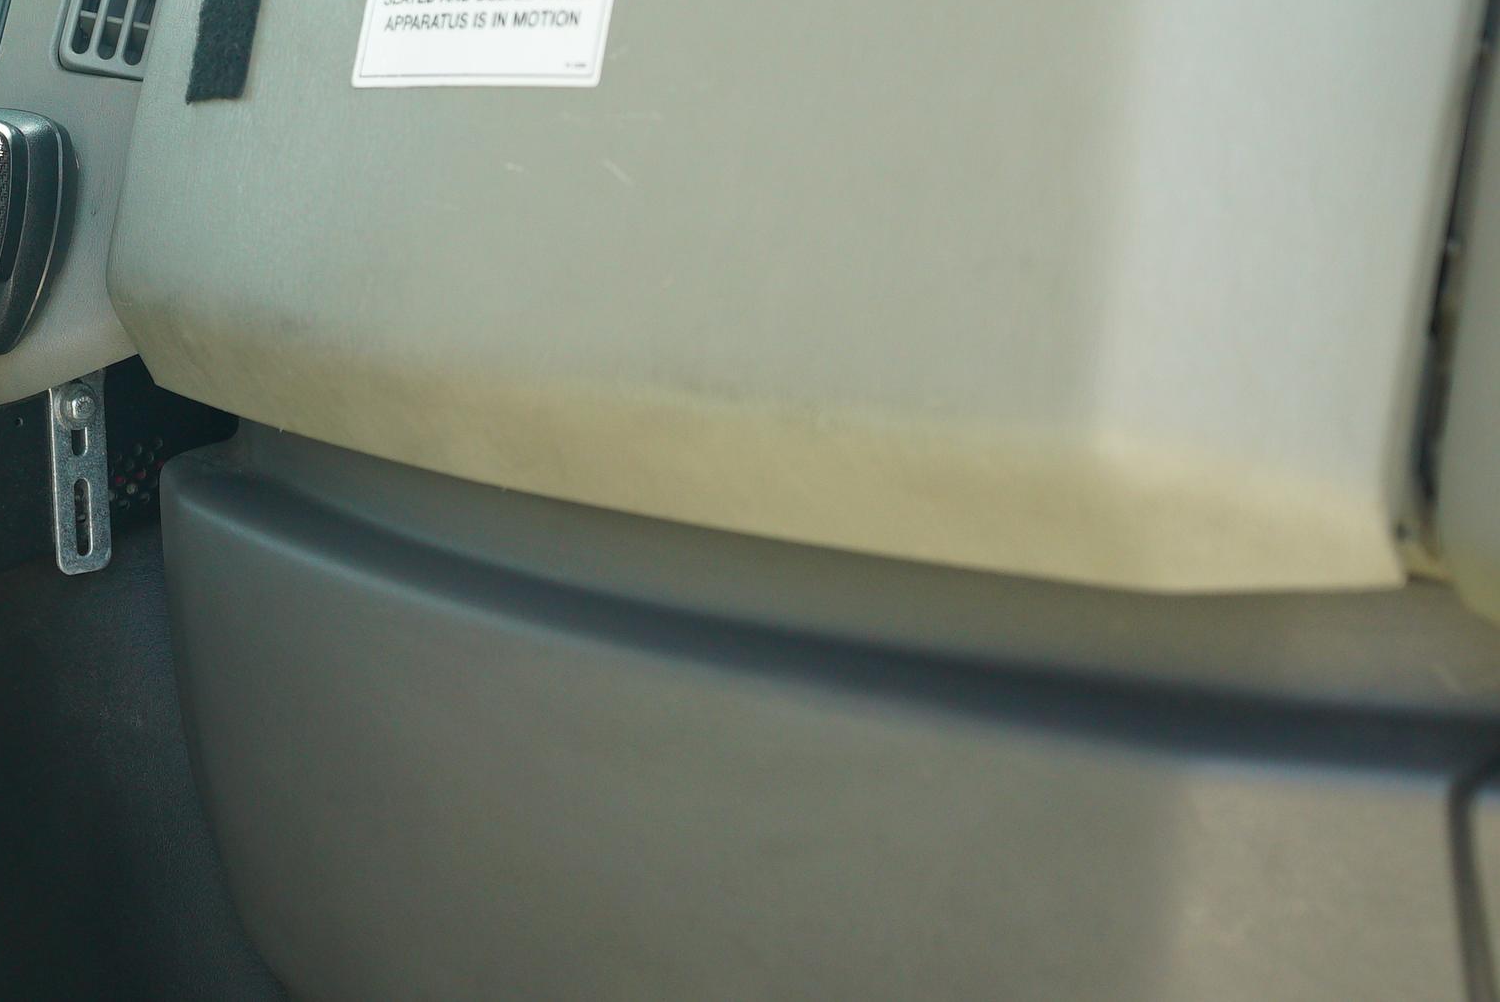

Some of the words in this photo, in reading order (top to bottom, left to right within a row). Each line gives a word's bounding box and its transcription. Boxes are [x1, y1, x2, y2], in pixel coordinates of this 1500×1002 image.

[384, 11, 468, 32] APPARATUS
[472, 10, 487, 29] IS
[491, 10, 507, 28] IN
[512, 9, 581, 28] MOTION
